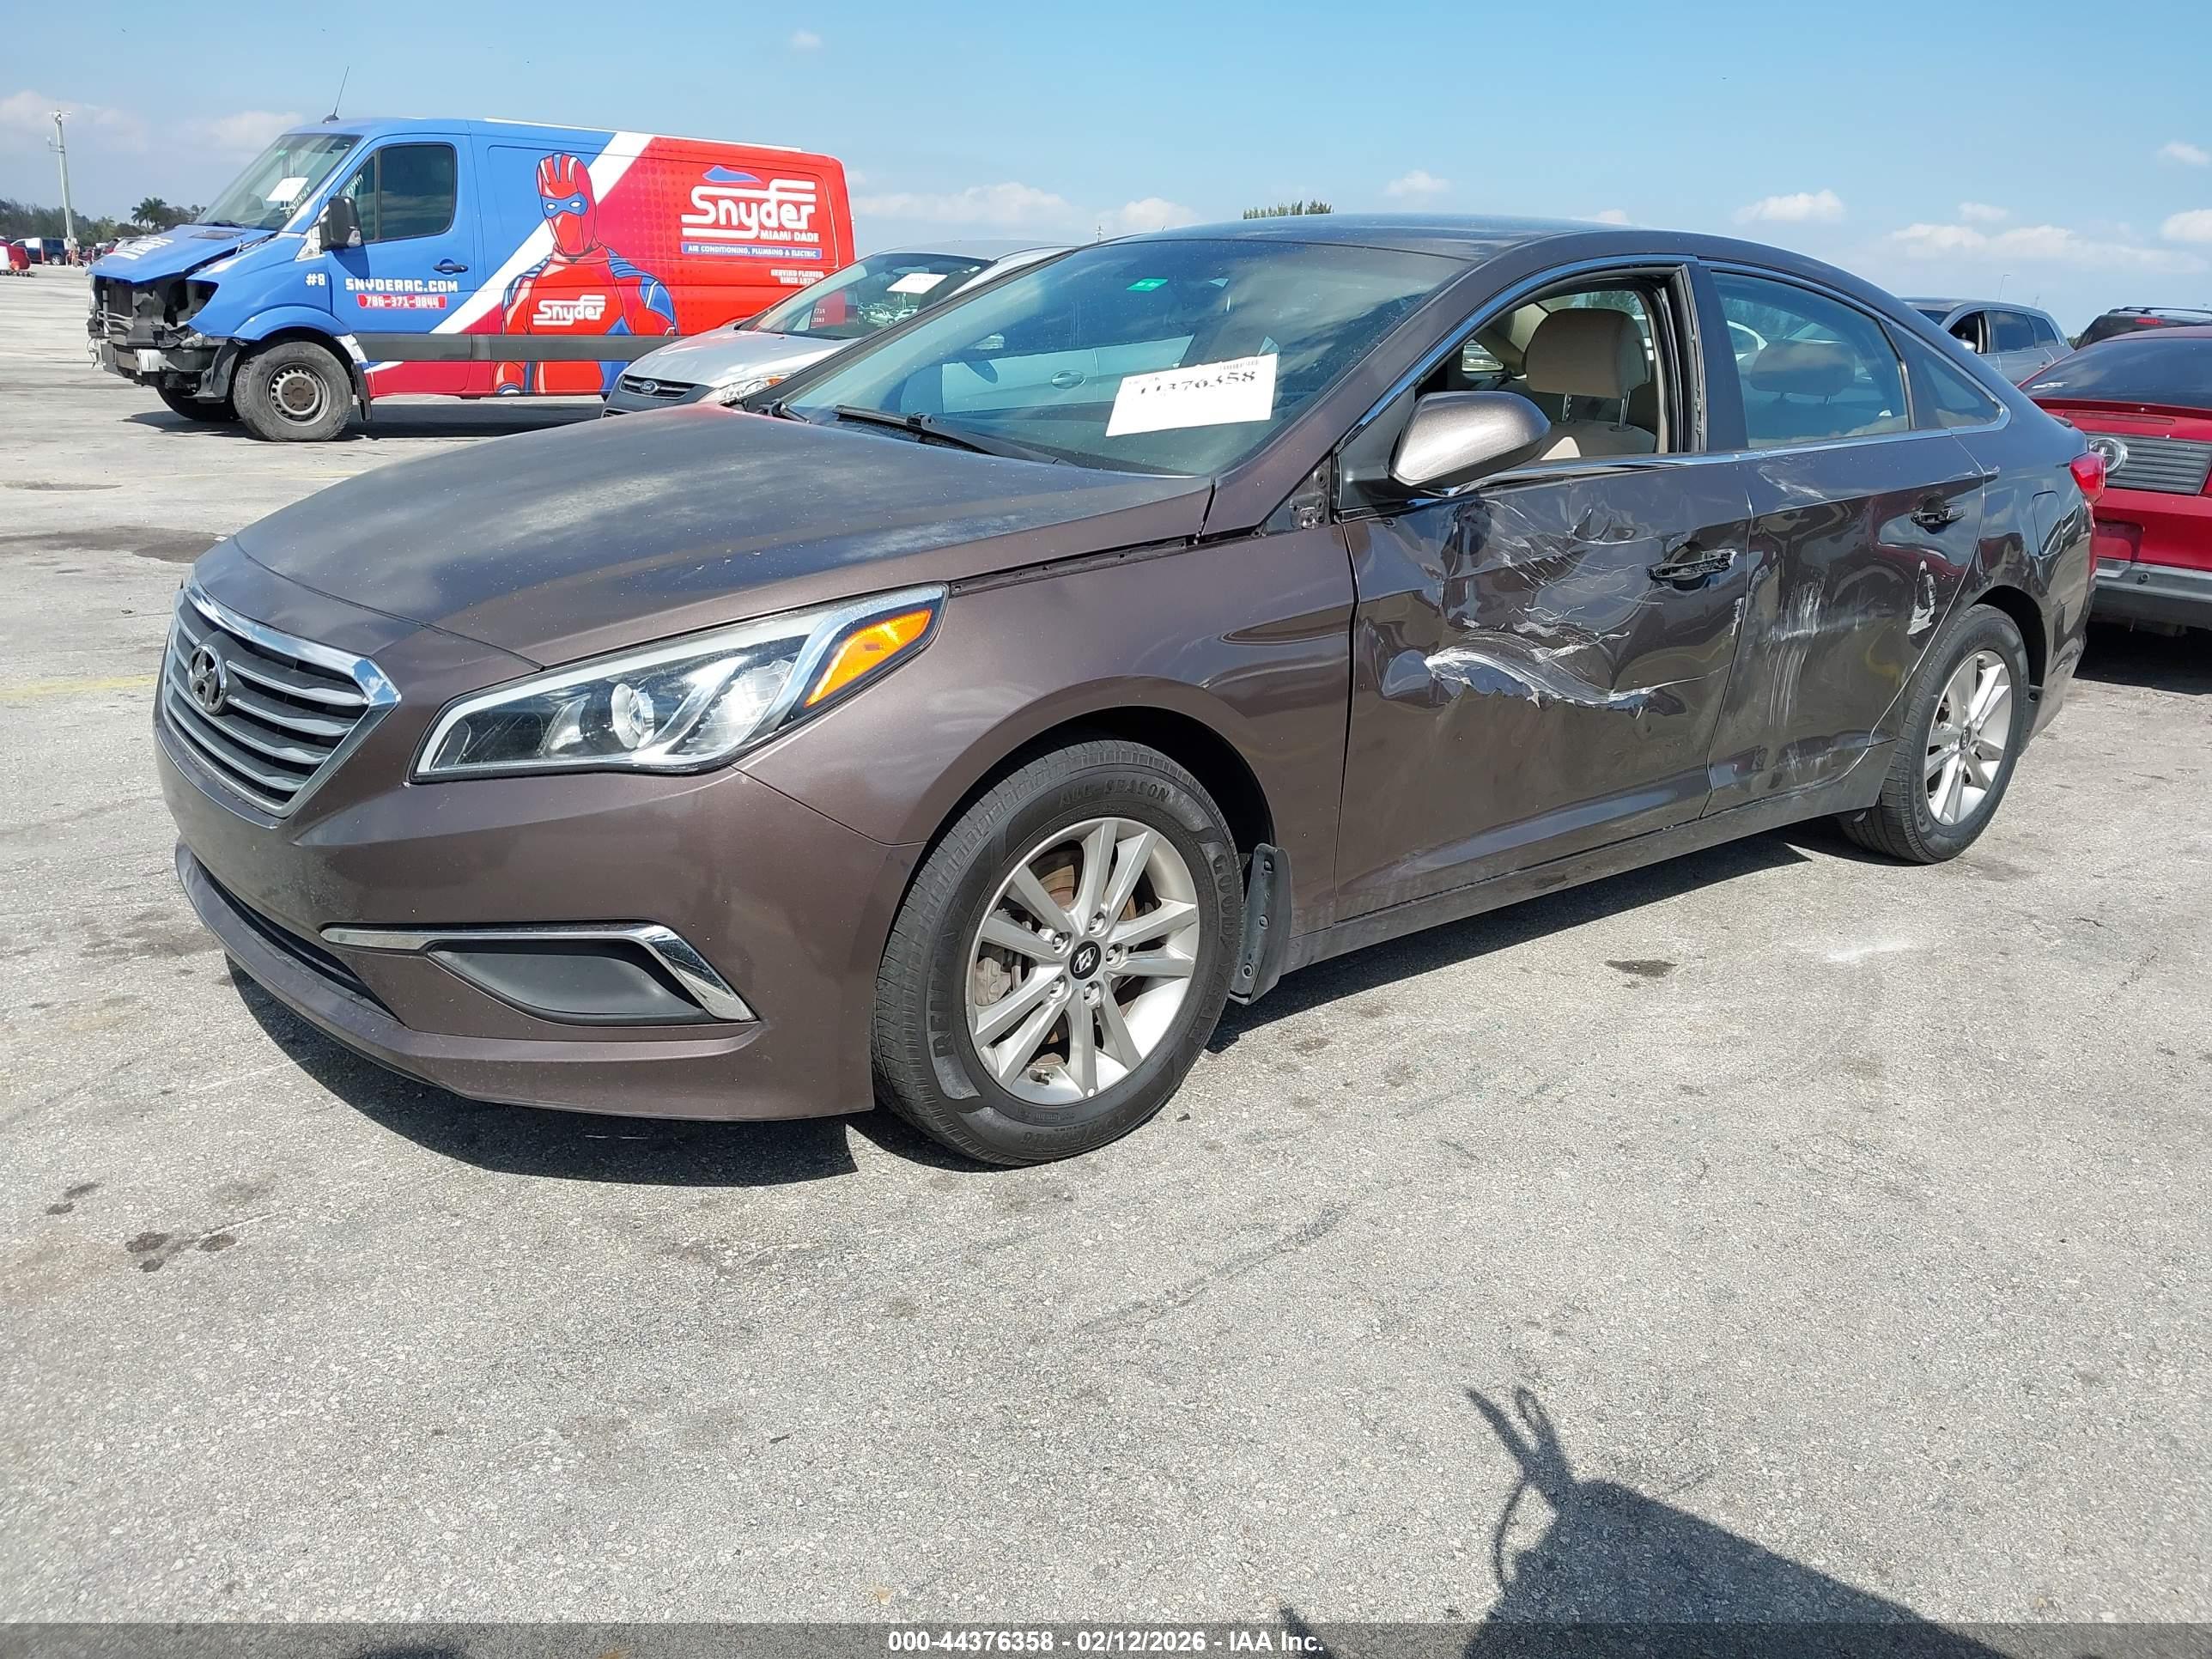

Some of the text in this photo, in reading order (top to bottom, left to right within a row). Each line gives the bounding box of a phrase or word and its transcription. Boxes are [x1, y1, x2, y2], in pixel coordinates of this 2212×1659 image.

[681, 179, 816, 240] Snyder
[760, 230, 819, 243] MIAMI DADE
[701, 246, 750, 255] CONDITIONING,
[751, 247, 783, 256] PLUMBING
[791, 249, 816, 258] ELECTRIC
[306, 273, 325, 286] #8
[345, 278, 458, 292] SNYDERAC.COM
[532, 294, 606, 326] Snyder
